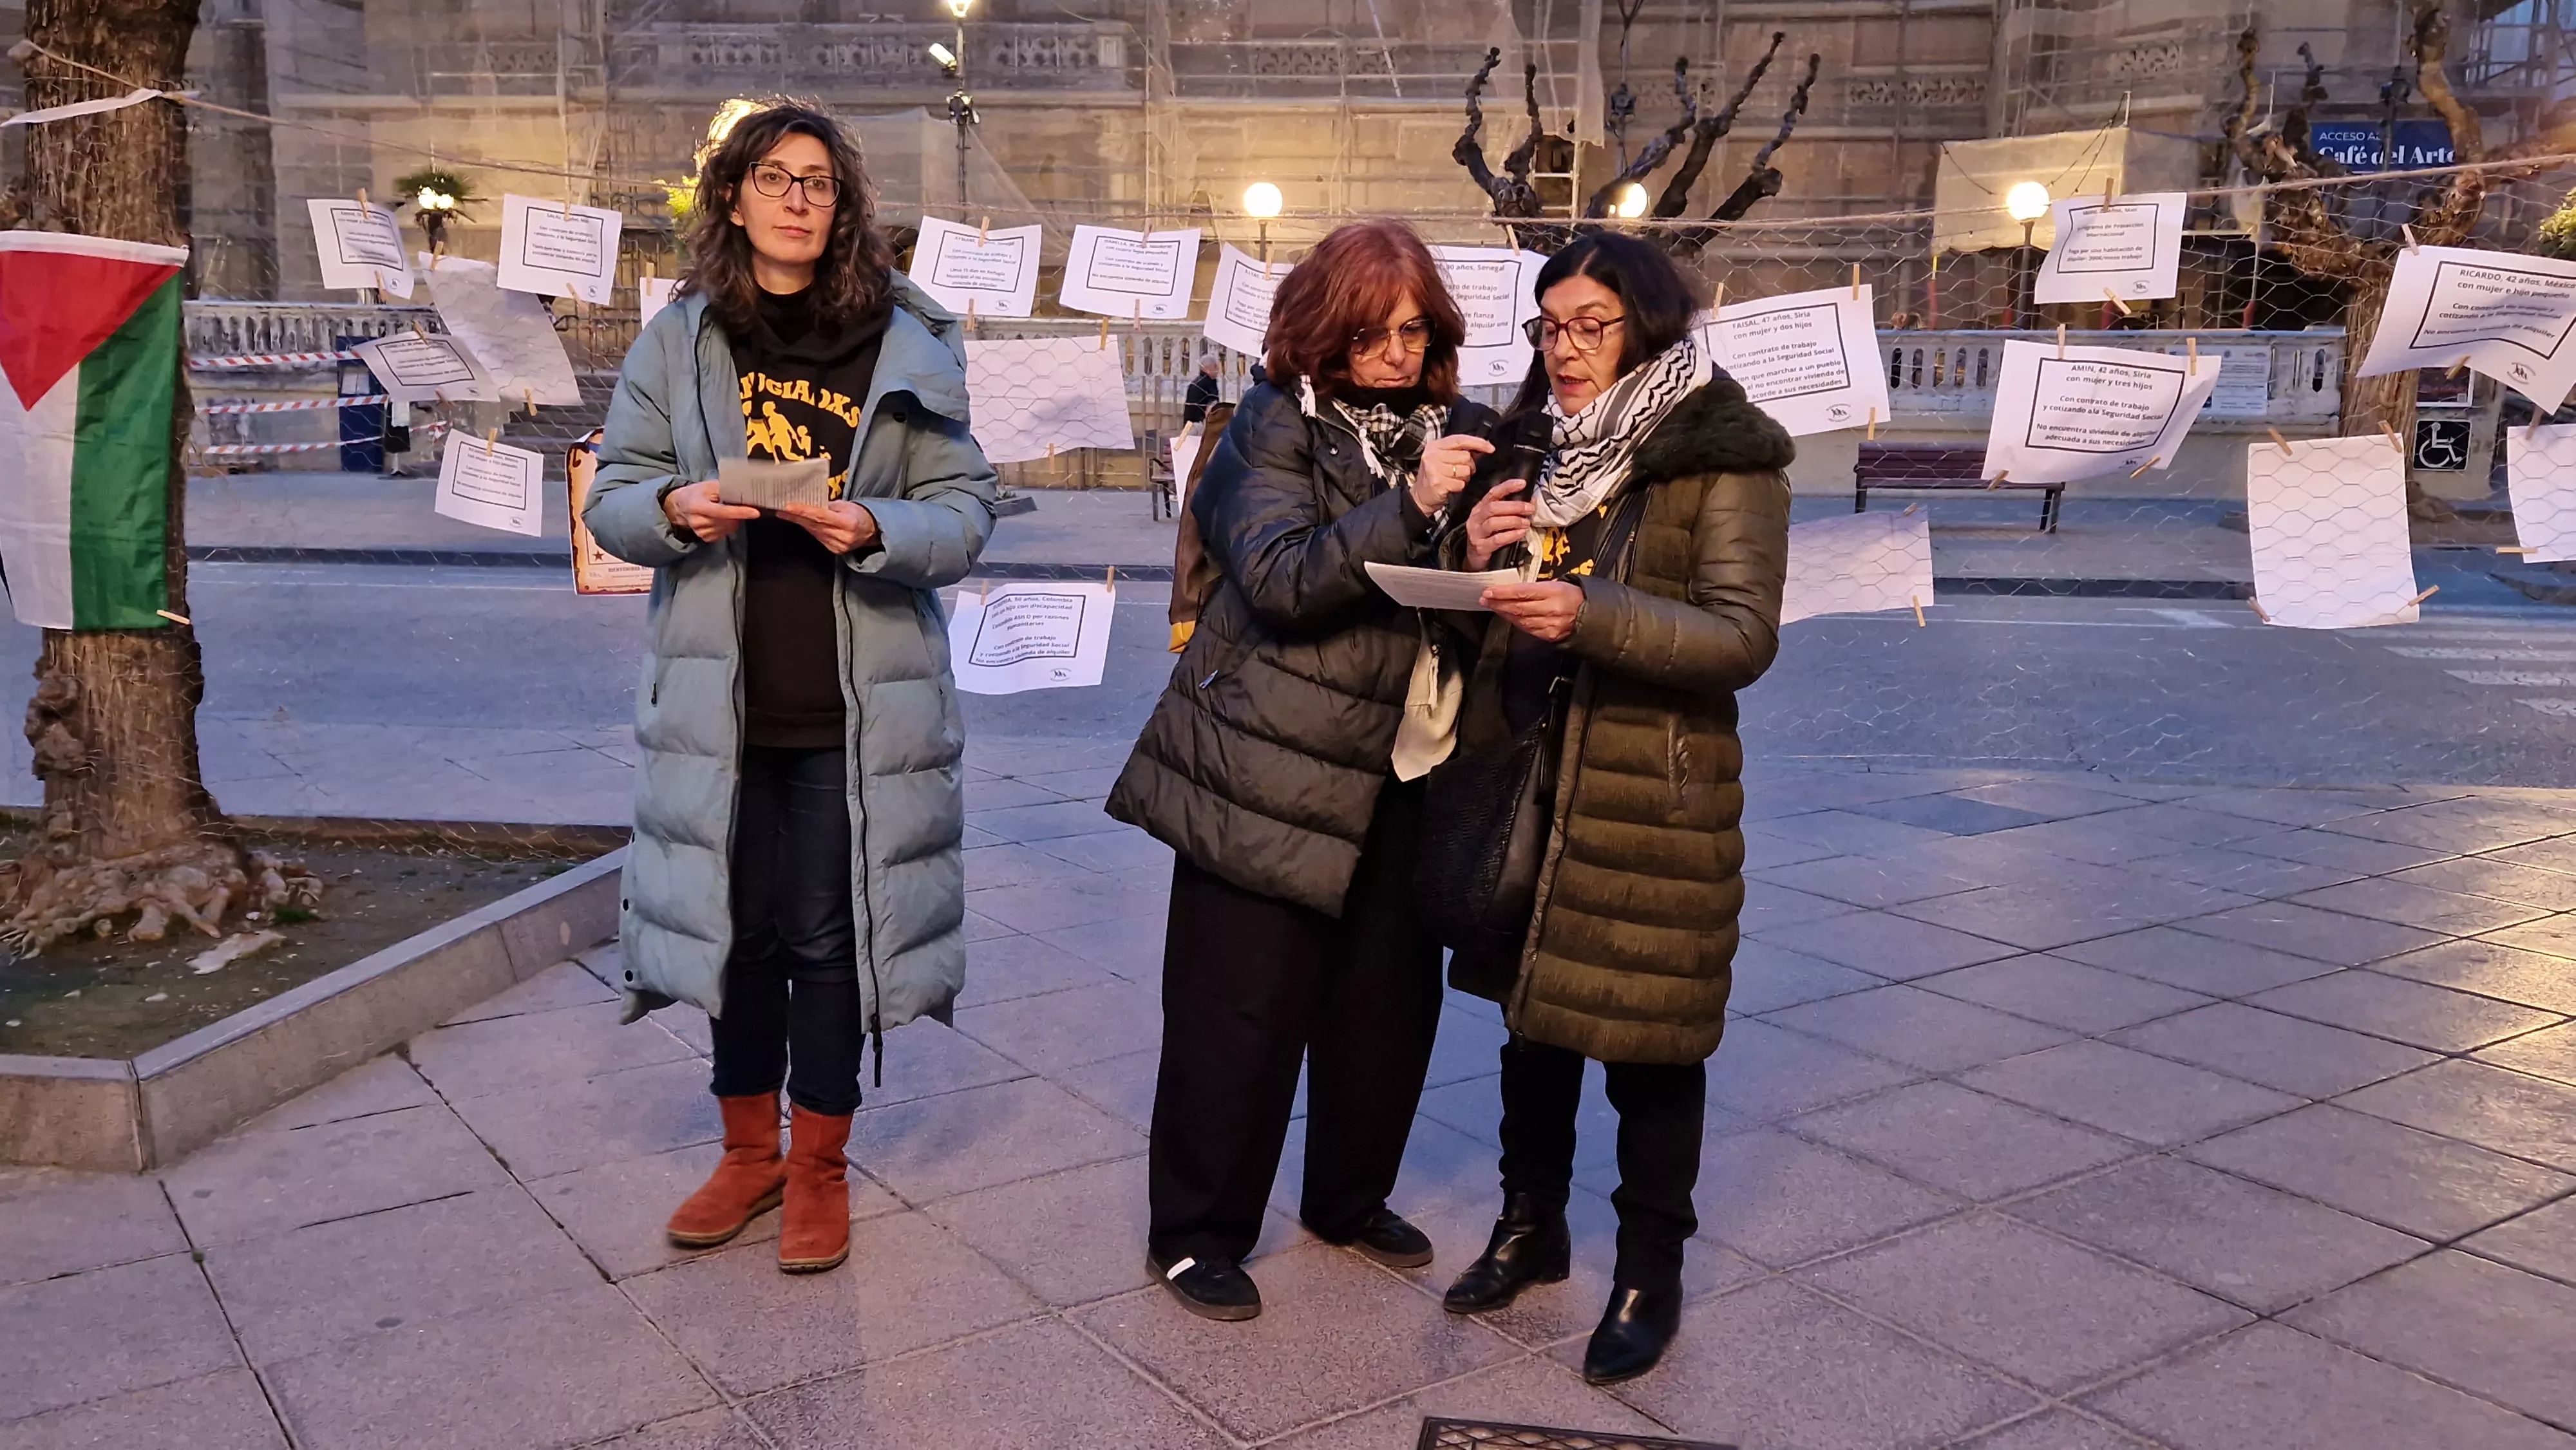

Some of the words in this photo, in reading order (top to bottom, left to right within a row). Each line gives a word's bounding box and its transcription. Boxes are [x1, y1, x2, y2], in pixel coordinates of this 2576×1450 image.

[2319, 132, 2365, 141] ACCESO
[2459, 270, 2503, 281] RICARDO,
[2518, 278, 2541, 286] años,
[2544, 279, 2576, 288] México
[2476, 285, 2503, 294] mujer
[1749, 328, 1771, 337] mujer
[1795, 321, 1812, 330] hijos
[2523, 325, 2555, 339] alquiler
[1748, 346, 1779, 357] contrato
[1792, 341, 1817, 350] trabajo
[1726, 360, 1761, 371] cotizando
[1777, 351, 1812, 361] Seguridad
[1767, 367, 1797, 377] marchar
[1817, 360, 1841, 370] pueblo
[2071, 364, 2096, 373] AMIN,
[2109, 369, 2130, 377] años,
[1766, 376, 1802, 387] encontrar
[1804, 371, 1834, 381] vivienda
[2134, 382, 2153, 390] hijos
[1752, 390, 1776, 399] acorde
[1798, 379, 1842, 391] necesidades
[2077, 397, 2108, 406] contrato
[2121, 402, 2150, 411] trabajo
[2101, 409, 2140, 420] Seguridad
[2049, 426, 2087, 434] encuentra
[2045, 434, 2080, 443] adecuada
